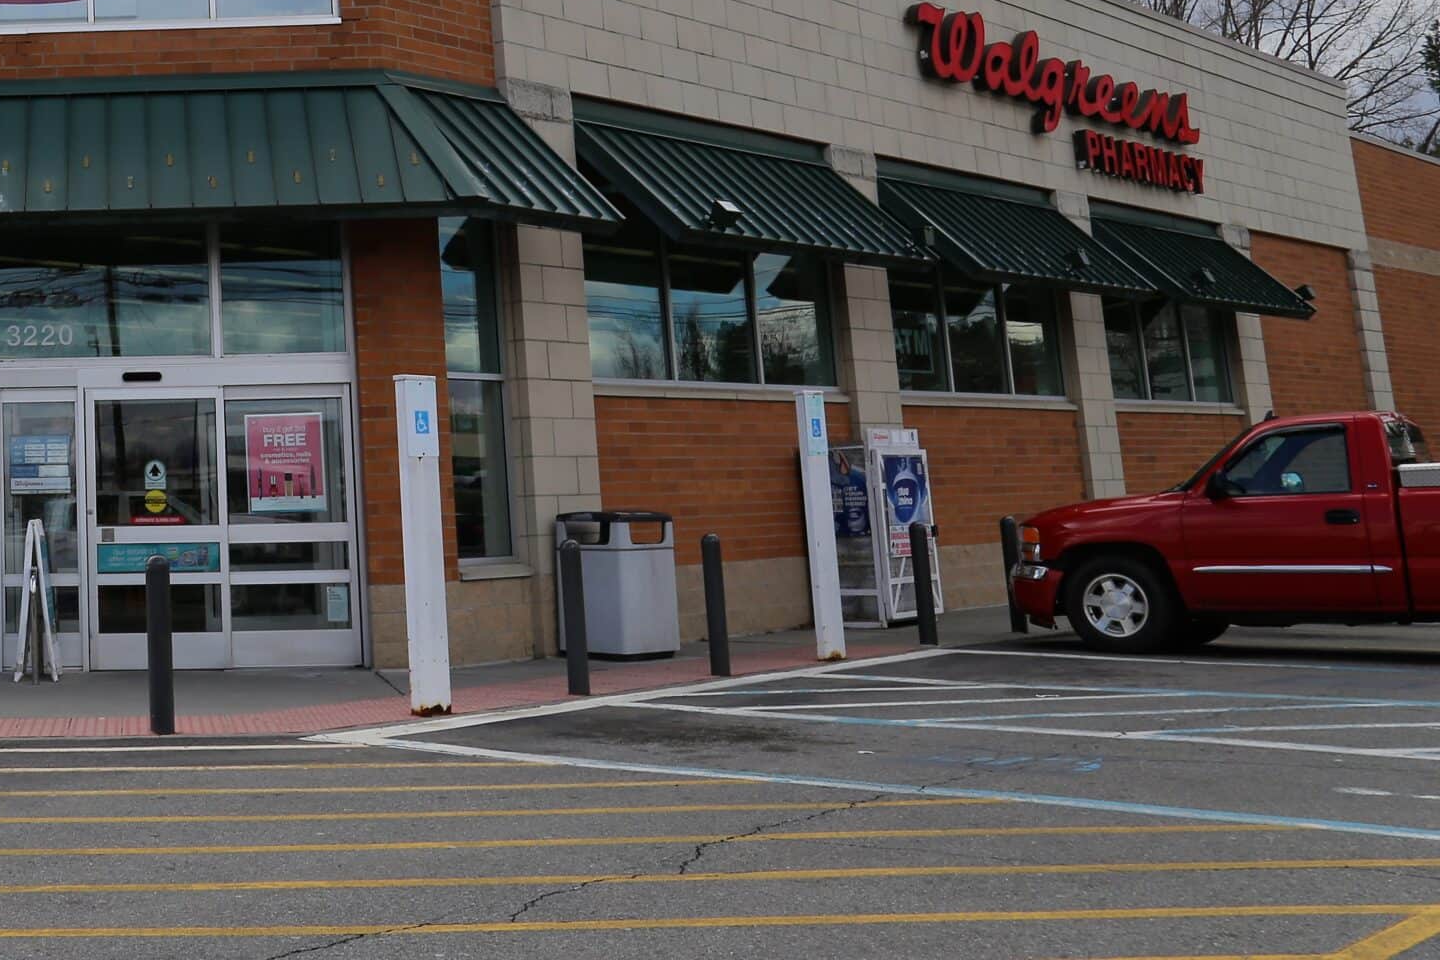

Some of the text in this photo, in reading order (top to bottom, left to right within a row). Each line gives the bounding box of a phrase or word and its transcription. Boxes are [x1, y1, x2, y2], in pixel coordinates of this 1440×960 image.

[910, 2, 1200, 144] Walgreens
[1078, 129, 1204, 194] PHARMACY
[7, 324, 73, 346] 3220
[895, 328, 929, 355] ATM
[263, 433, 307, 447] FREE
